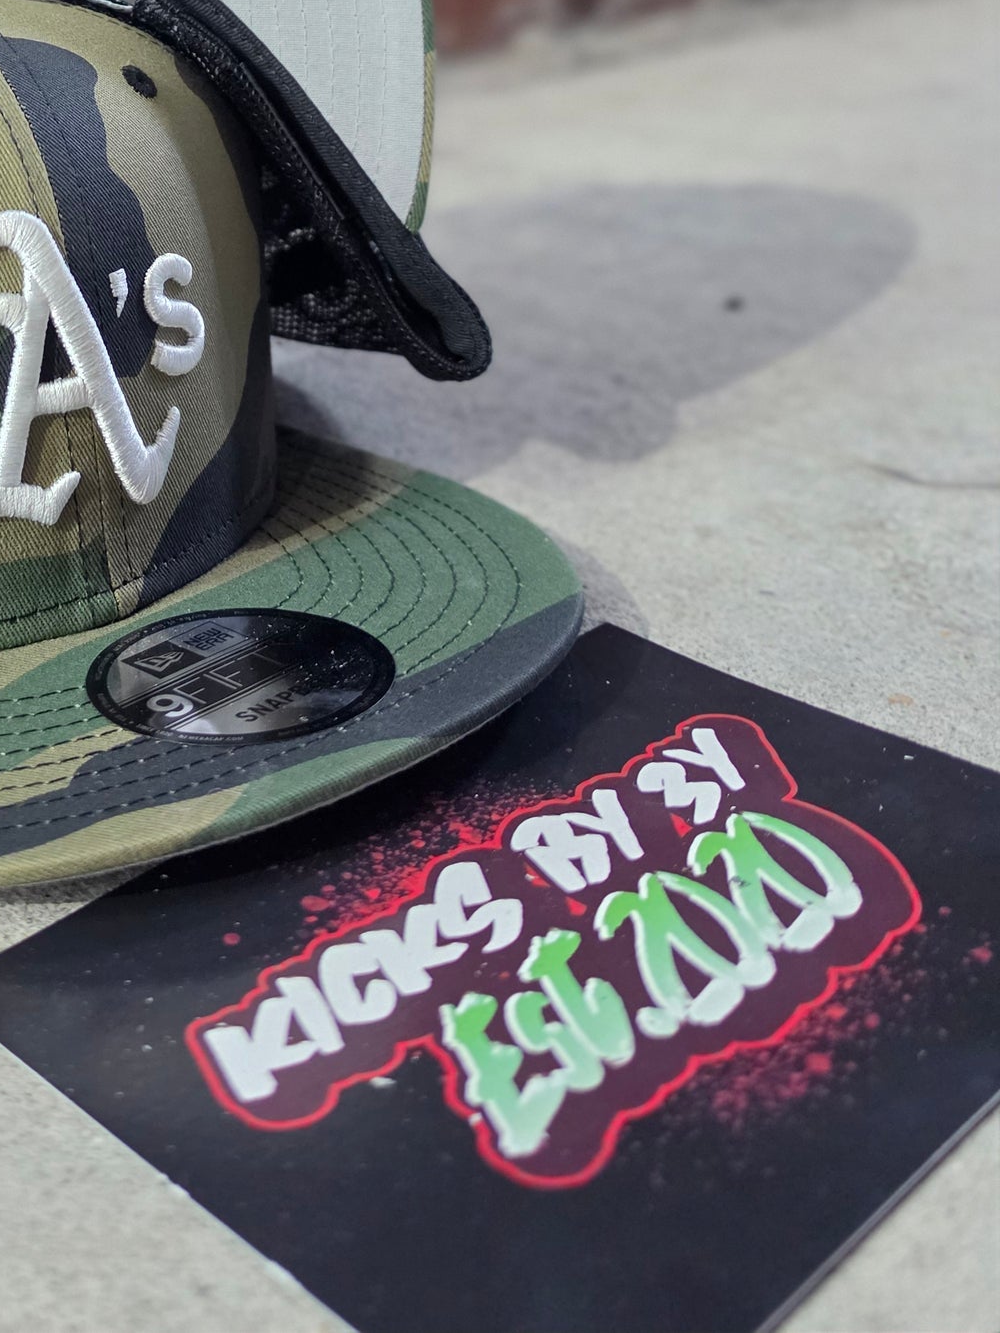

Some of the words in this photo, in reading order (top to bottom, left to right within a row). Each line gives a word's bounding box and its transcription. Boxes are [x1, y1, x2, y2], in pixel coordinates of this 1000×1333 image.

[183, 627, 222, 647] NEW
[196, 632, 237, 651] ERA
[204, 862, 524, 1103] KICKS
[510, 788, 645, 893] BY
